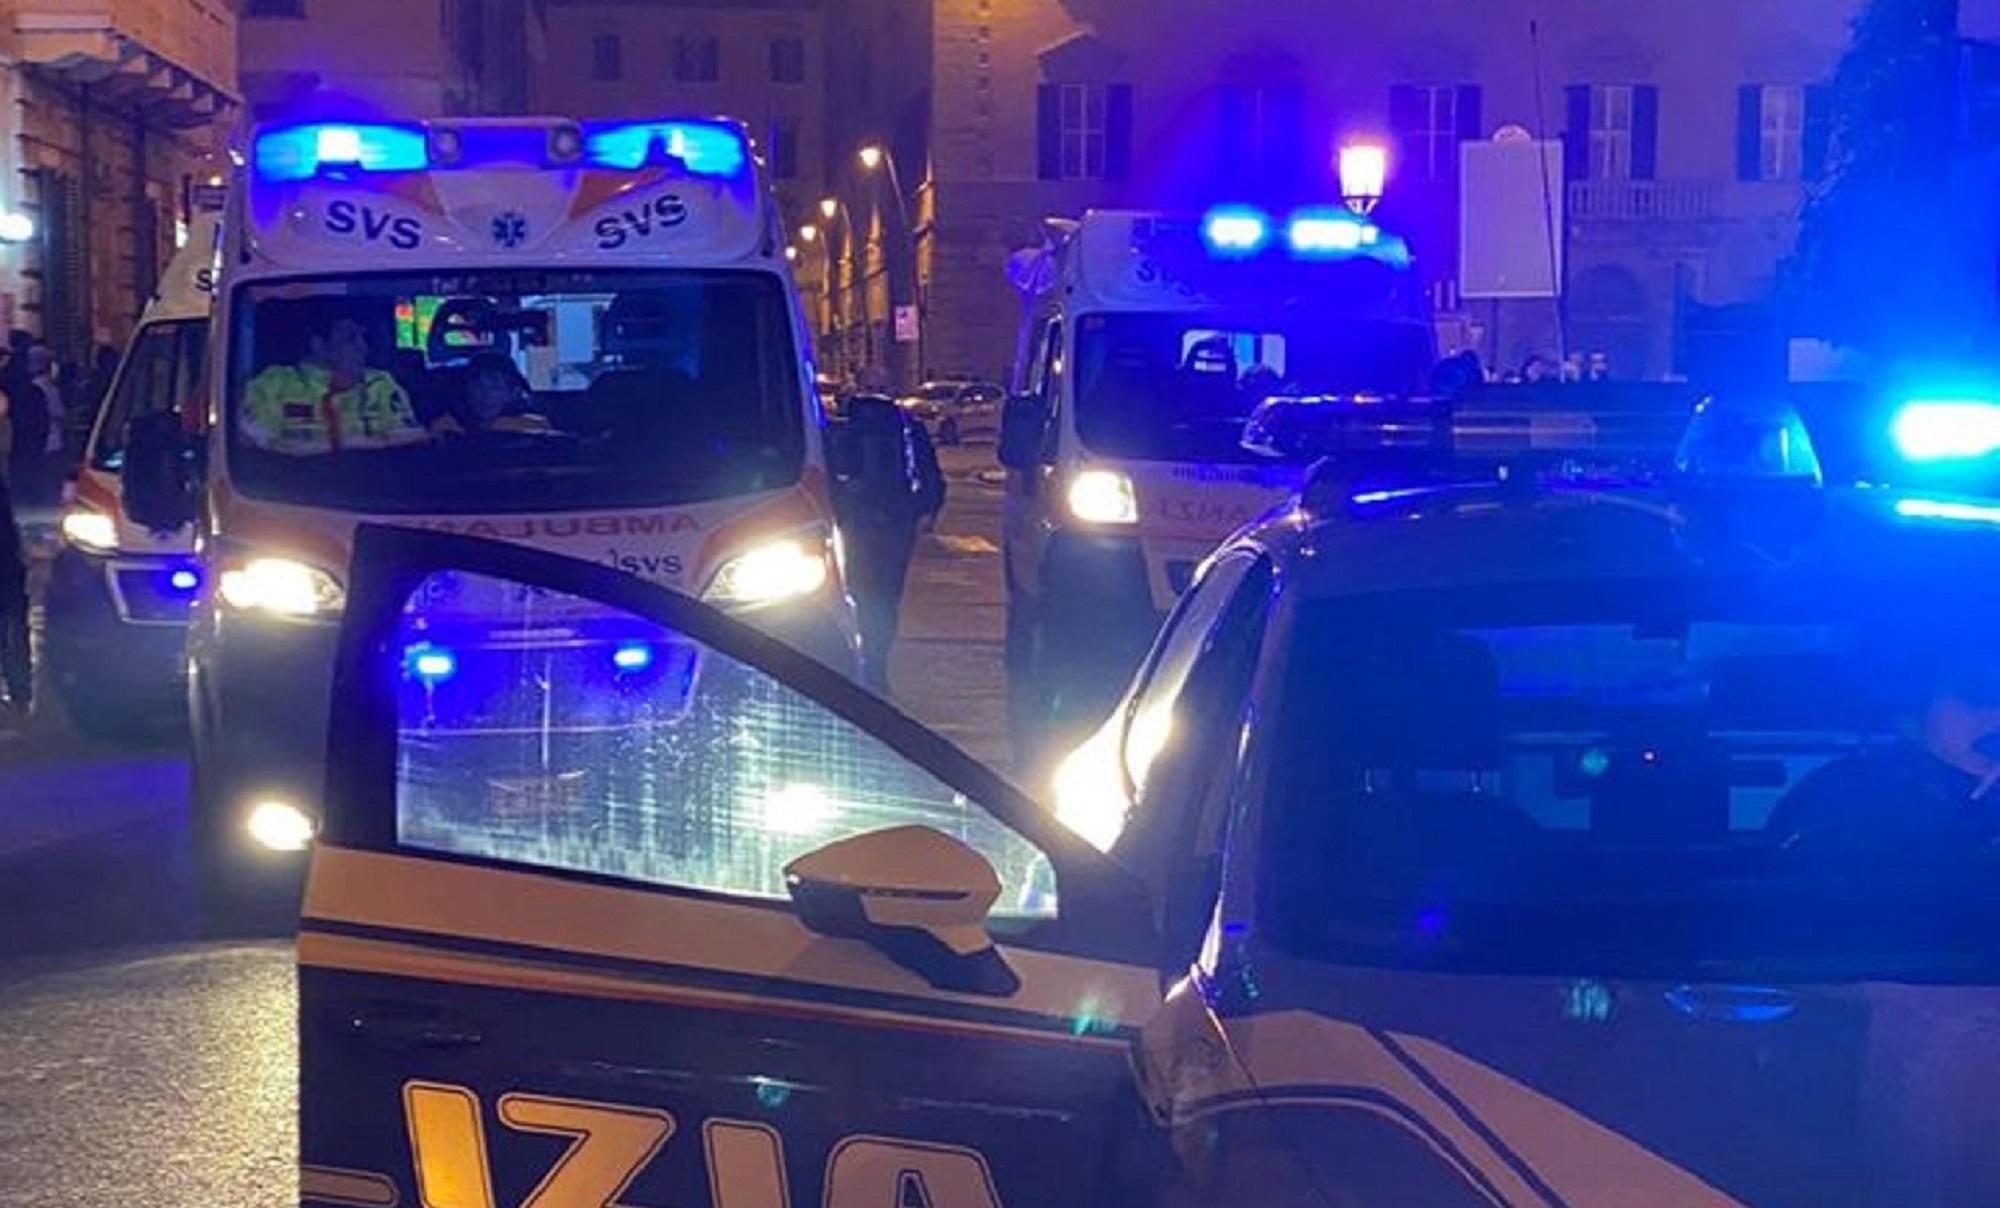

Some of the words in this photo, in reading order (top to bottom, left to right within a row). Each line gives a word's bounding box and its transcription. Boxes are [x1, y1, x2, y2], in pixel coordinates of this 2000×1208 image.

[325, 200, 422, 249] SVS
[595, 195, 688, 249] SVS
[196, 268, 213, 291] S
